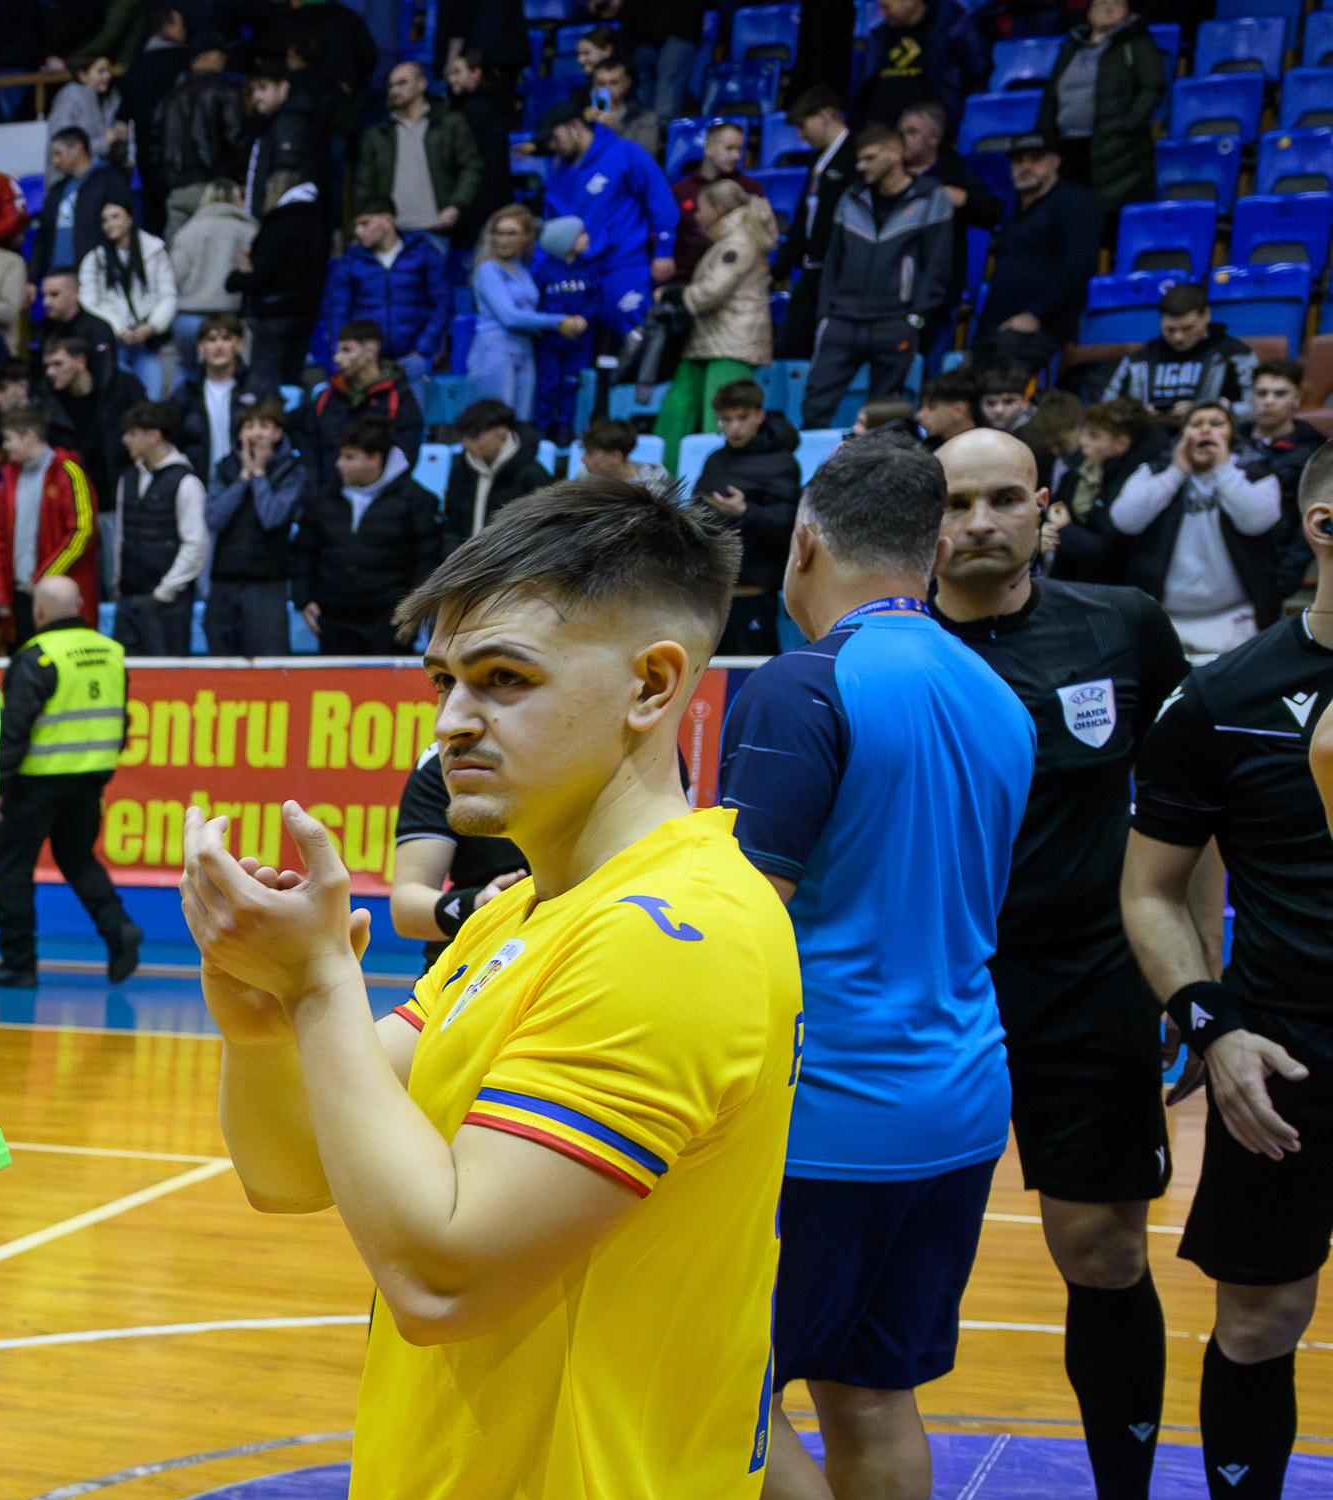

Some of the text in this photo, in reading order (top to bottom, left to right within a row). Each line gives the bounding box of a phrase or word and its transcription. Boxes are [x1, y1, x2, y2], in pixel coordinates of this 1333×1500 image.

[118, 689, 289, 769] entru
[1074, 716, 1112, 731] OFFICIAL
[1076, 707, 1108, 721] MATCH
[101, 790, 399, 883] enru su
